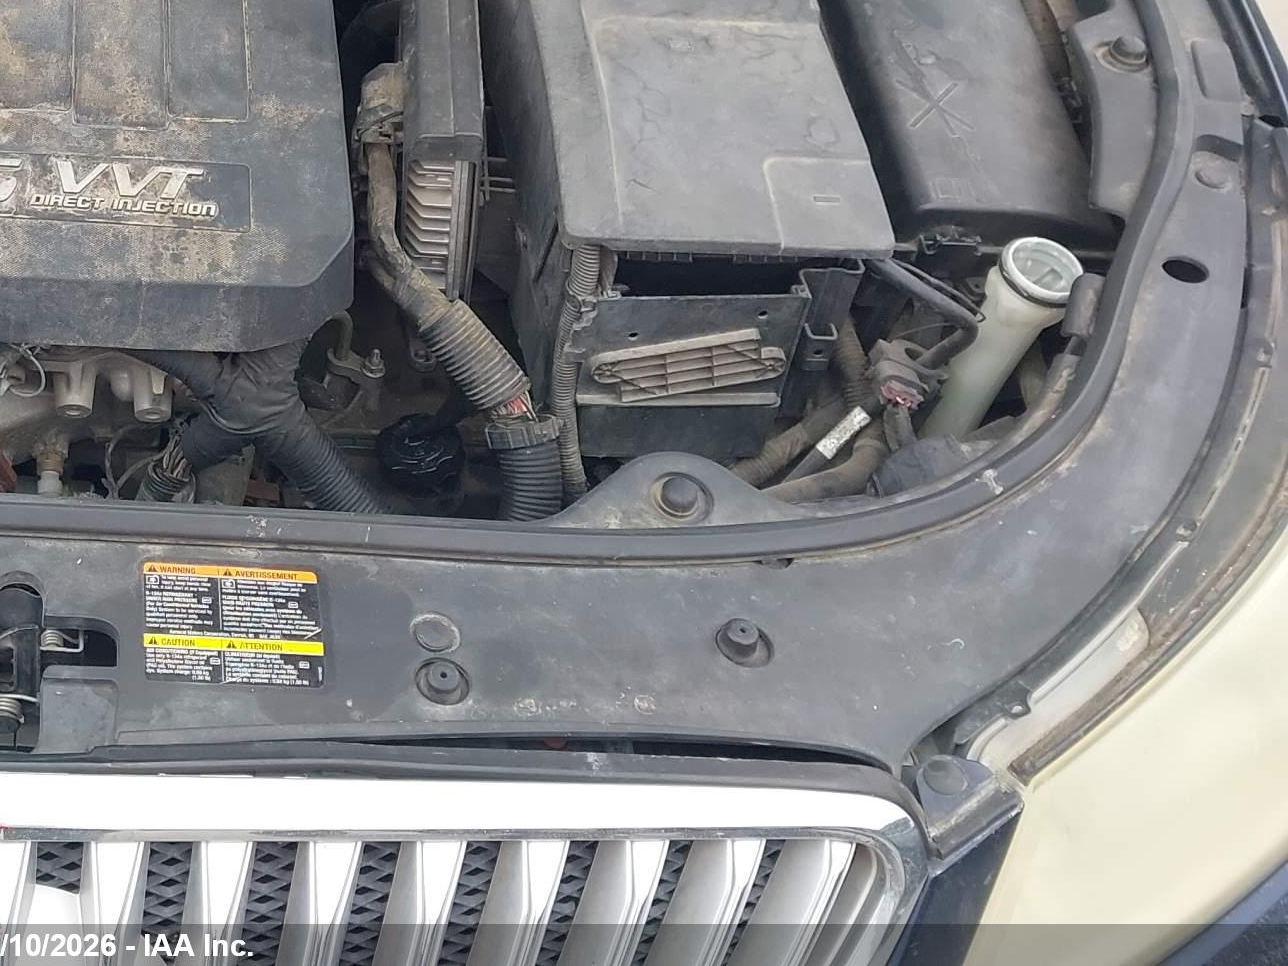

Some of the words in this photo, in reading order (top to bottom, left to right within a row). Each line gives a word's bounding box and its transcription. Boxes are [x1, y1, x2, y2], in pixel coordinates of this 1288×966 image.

[53, 159, 206, 200] VVT
[30, 194, 105, 210] DIRECT
[110, 198, 217, 218] INJECTION
[159, 566, 196, 575] WARNING
[234, 570, 298, 581] AVERTISSEMENT
[160, 638, 196, 647] CAUTION
[239, 641, 283, 651] ATTENTION
